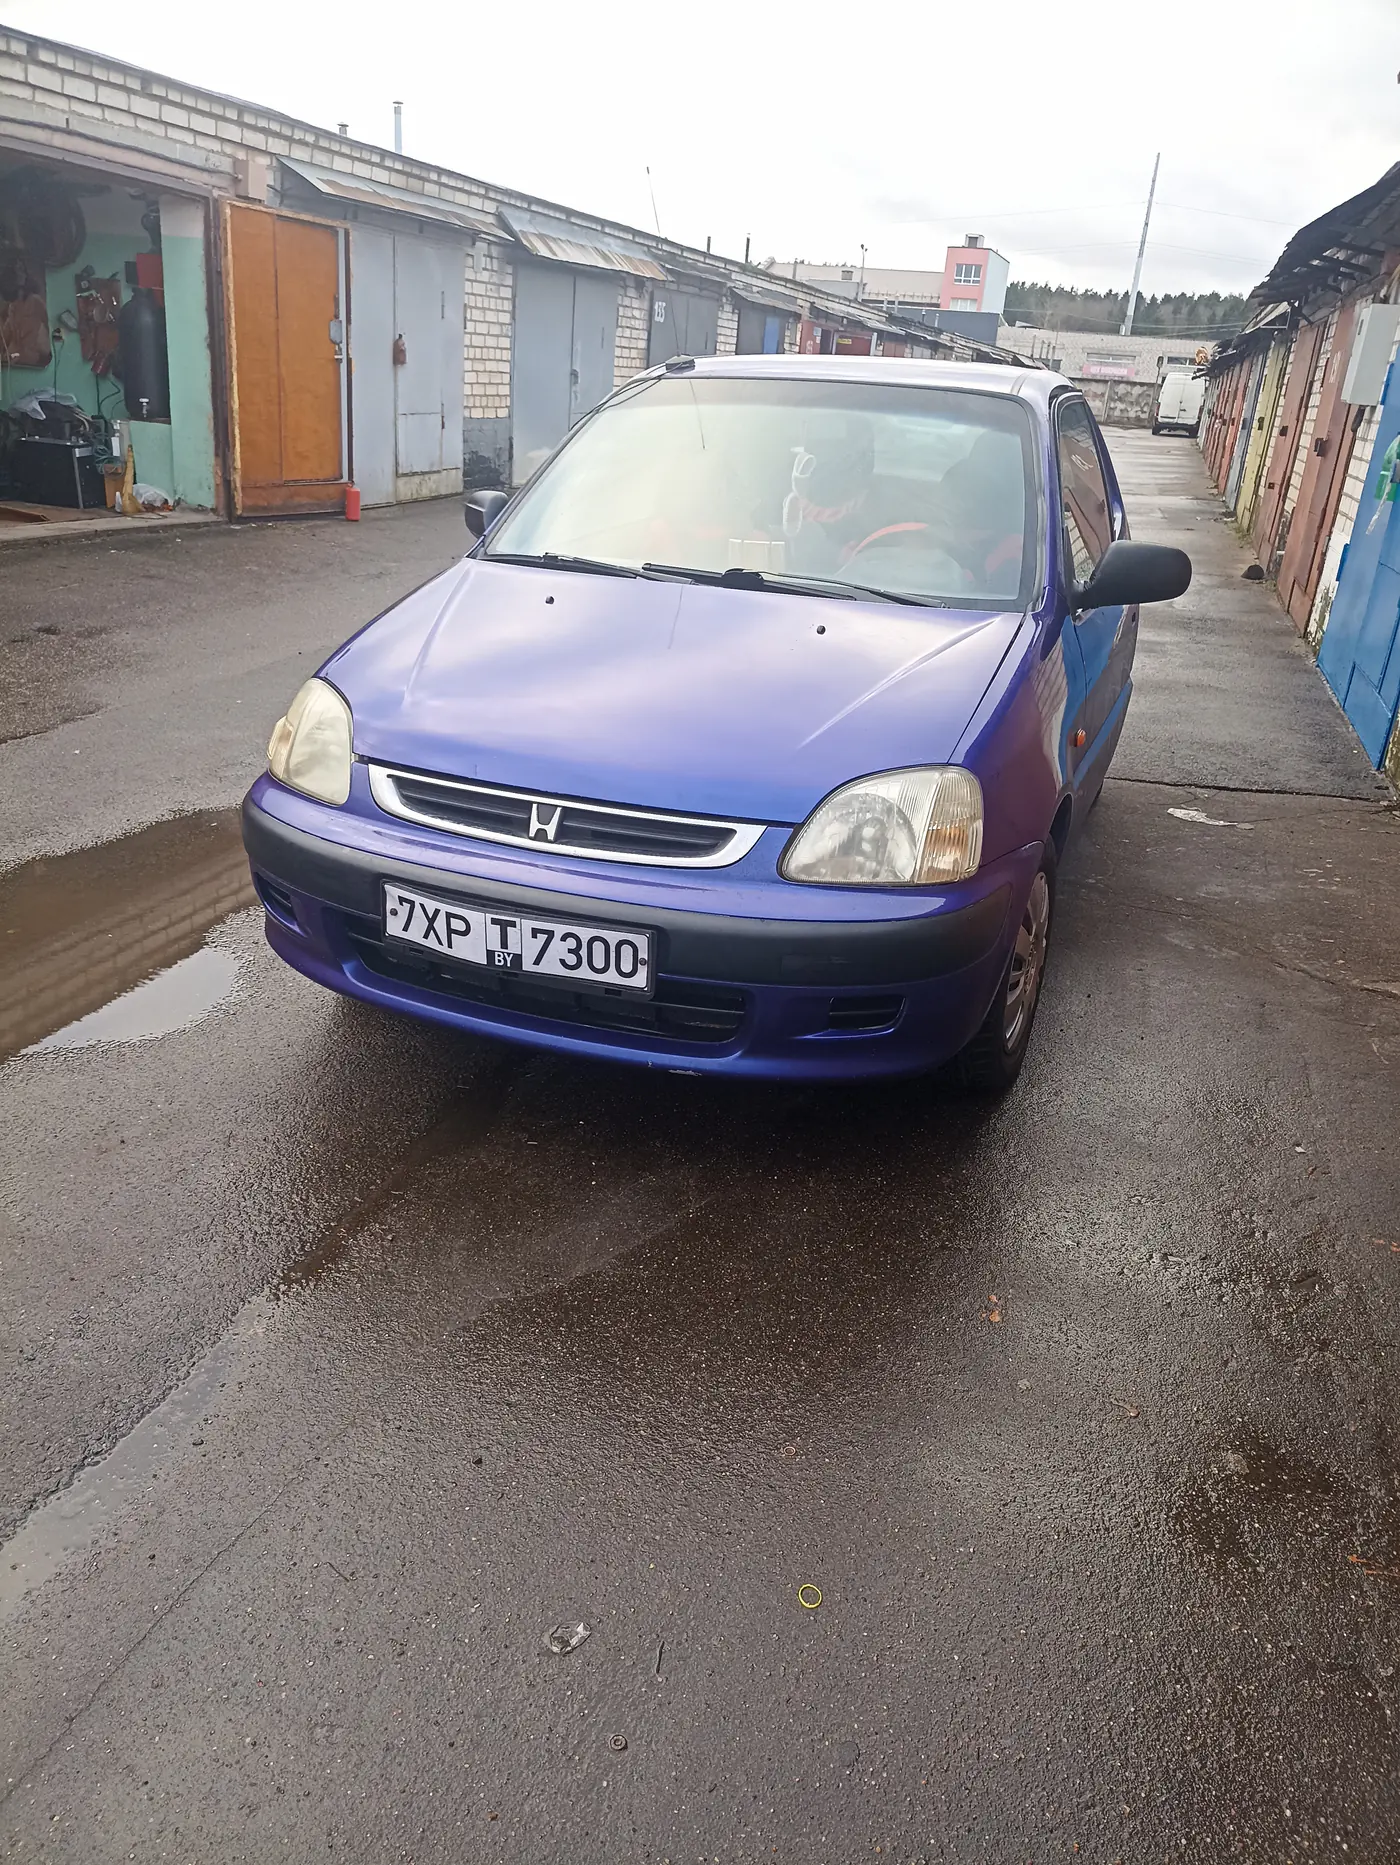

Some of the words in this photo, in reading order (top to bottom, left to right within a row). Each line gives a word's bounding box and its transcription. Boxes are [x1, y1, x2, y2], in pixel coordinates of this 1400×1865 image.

[397, 894, 472, 950] 7XP
[490, 917, 517, 950] T
[530, 926, 640, 979] 7300
[494, 951, 514, 968] BY
